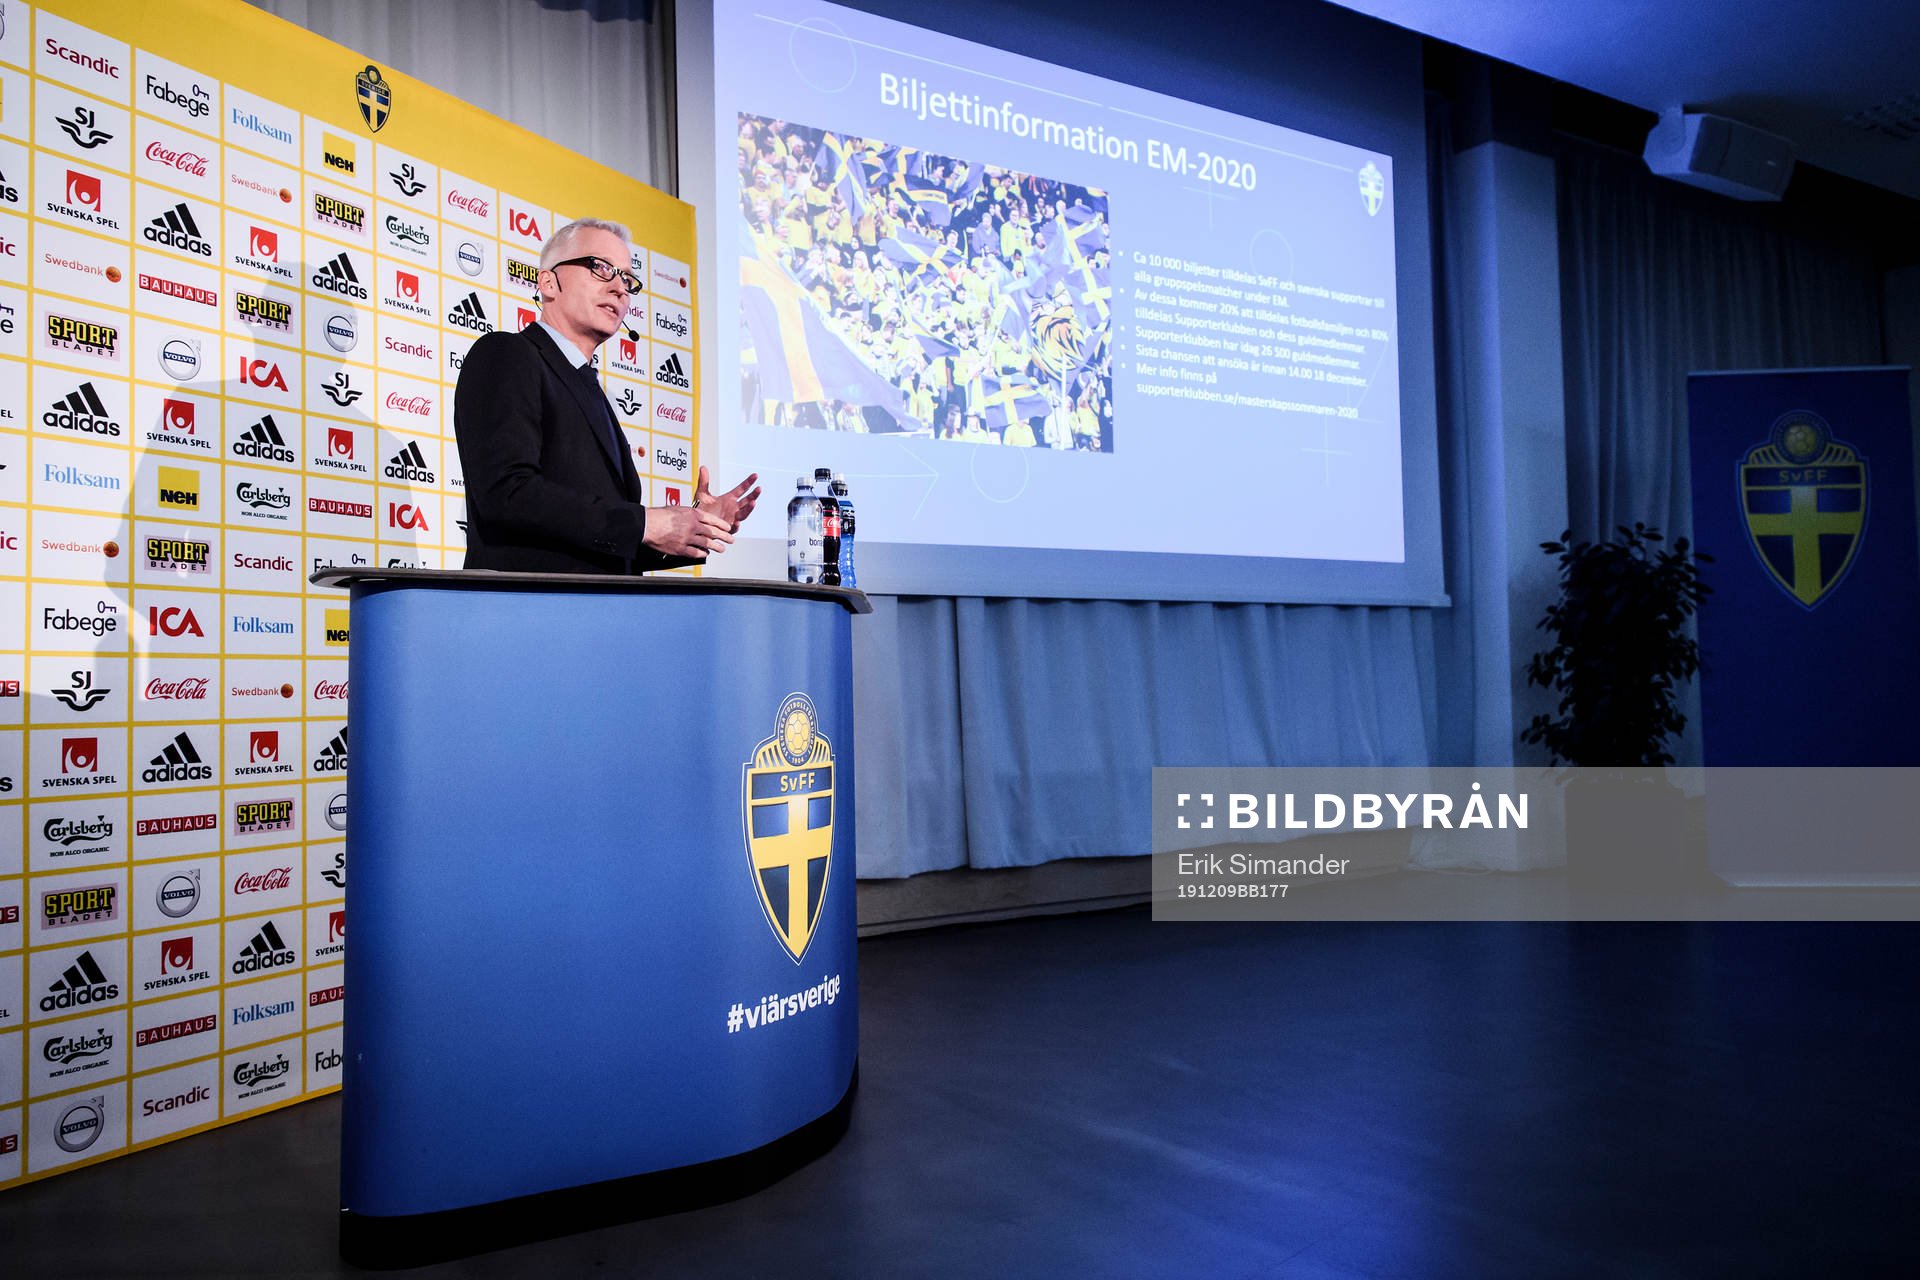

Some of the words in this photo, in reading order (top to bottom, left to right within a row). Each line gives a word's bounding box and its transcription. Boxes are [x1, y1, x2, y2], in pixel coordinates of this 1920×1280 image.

[46, 39, 119, 78] Scandic
[146, 75, 210, 117] Fabege
[75, 107, 94, 128] SJ
[232, 108, 293, 144] Folksam
[880, 72, 1138, 163] Biljettinformation
[1147, 140, 1256, 190] EM-2020
[145, 141, 210, 178] Coca-Cola
[402, 163, 414, 180] SJ
[231, 174, 278, 197] Swedbank
[315, 194, 364, 226] SPORT
[448, 189, 488, 218] Coca-Cola
[47, 203, 93, 223] SVENSKA
[96, 215, 120, 230] SPEL
[317, 213, 362, 232] BLADET
[510, 208, 542, 241] ICA
[144, 225, 212, 257] adidas
[386, 215, 429, 245] Carlsberg
[45, 253, 104, 277] Swedbank
[235, 255, 272, 273] SVENSKA
[274, 264, 293, 279] SPEL
[1133, 251, 1146, 265] Ca
[1149, 254, 1161, 266] 10
[1163, 256, 1181, 270] 000
[1183, 260, 1220, 278] biljetter
[1280, 279, 1296, 291] och
[139, 276, 217, 306] BAUHAUS
[313, 274, 367, 299] adidas
[1134, 271, 1152, 284] alla
[1244, 290, 1270, 304] under
[237, 293, 291, 324] SPORT
[385, 298, 414, 312] SVENSKA
[416, 305, 431, 316] SPEL
[1134, 288, 1147, 300] Av
[1149, 291, 1177, 306] dessa
[1179, 296, 1218, 312] kommer
[1219, 303, 1239, 316] 20%
[1241, 308, 1253, 318] att
[1256, 308, 1289, 325] tilldelas
[1355, 325, 1370, 338] och
[48, 314, 117, 350] SPORT
[239, 313, 289, 331] BLADET
[329, 327, 353, 336] VOLVO
[448, 312, 493, 333] adidas
[656, 313, 687, 336] Fabege
[1135, 307, 1173, 323] tilldelas
[1175, 313, 1257, 335] Supporterklubben
[1259, 326, 1275, 339] och
[1277, 330, 1296, 342] dess
[52, 339, 115, 357] BLADET
[385, 337, 433, 360] Scandic
[1135, 325, 1221, 348] Supporterklubben
[1223, 340, 1238, 352] har
[1240, 342, 1259, 357] idag
[1262, 344, 1274, 357] 26
[1275, 347, 1290, 359] 500
[164, 353, 195, 364] VOLVO
[612, 361, 632, 371] SVENSKA
[634, 367, 645, 375] SPEL
[1135, 343, 1158, 358] Sista
[1161, 348, 1200, 363] chansen
[1202, 354, 1215, 365] att
[1217, 357, 1249, 371] ansöka
[1251, 361, 1260, 372] är
[1262, 363, 1286, 376] innan
[1288, 366, 1312, 379] 14.00
[1314, 369, 1325, 381] 18
[240, 356, 289, 392] ICA
[335, 372, 349, 388] SJ
[656, 371, 689, 388] adidas
[1136, 363, 1157, 377] Mer
[1159, 365, 1178, 379] info
[1180, 367, 1203, 383] finns
[1205, 372, 1217, 384] på
[386, 391, 432, 416] Coca-Cola
[625, 389, 633, 401] SJ
[43, 410, 120, 436] adidas
[657, 403, 687, 423] Coca-Cola
[147, 433, 188, 446] SVENSKA
[190, 438, 211, 449] SPEL
[233, 440, 294, 463] adidas
[315, 458, 348, 469] SVENSKA
[350, 463, 367, 472] SPEL
[657, 449, 687, 471] Fabege
[44, 463, 120, 490] Folksam
[385, 465, 435, 484] adidas
[1779, 469, 1828, 482] SvFF
[236, 482, 290, 507] Carlsberg
[310, 499, 372, 517] BAUHAUS
[389, 502, 429, 531] ICA
[41, 539, 101, 553] Swedbank
[147, 538, 210, 564] SPORT
[150, 561, 207, 571] BLADET
[234, 554, 293, 571] Scandic
[44, 608, 116, 636] Fabege
[150, 606, 205, 637] ICA
[233, 616, 294, 634] Folksam
[71, 671, 92, 689] SJ
[145, 678, 210, 700] Coca-Cola
[232, 687, 278, 697] Swedbank
[142, 763, 212, 783] adidas
[235, 766, 272, 775] SVENSKA
[275, 765, 293, 773] SPEL
[314, 757, 347, 771] adid
[42, 777, 90, 788] SVENSKA
[92, 775, 117, 785] SPEL
[780, 772, 815, 792] SvFF
[138, 815, 216, 834] BAUHAUS
[238, 802, 292, 825] SPORT
[43, 817, 113, 840] Carlsberg
[240, 821, 290, 832] BLADET
[234, 867, 292, 895] Coca-Cola
[45, 888, 116, 918] SPORT
[164, 891, 194, 899] VOLVO
[48, 911, 112, 926] BLADET
[232, 950, 295, 974] adidas
[316, 945, 344, 957] SVENSK
[144, 975, 187, 991] SVENSKA
[188, 971, 210, 983] SPEL
[40, 984, 119, 1012] adidas
[311, 988, 344, 1005] BAUH
[727, 973, 840, 1033] #viärsverige
[232, 1001, 294, 1025] Folksam
[138, 1016, 215, 1044] BAUHAUS
[43, 1033, 113, 1063] Carlsberg
[233, 1059, 289, 1086] Carlsberg
[143, 1086, 210, 1117] Scandic
[62, 1120, 97, 1133] VOLVO
